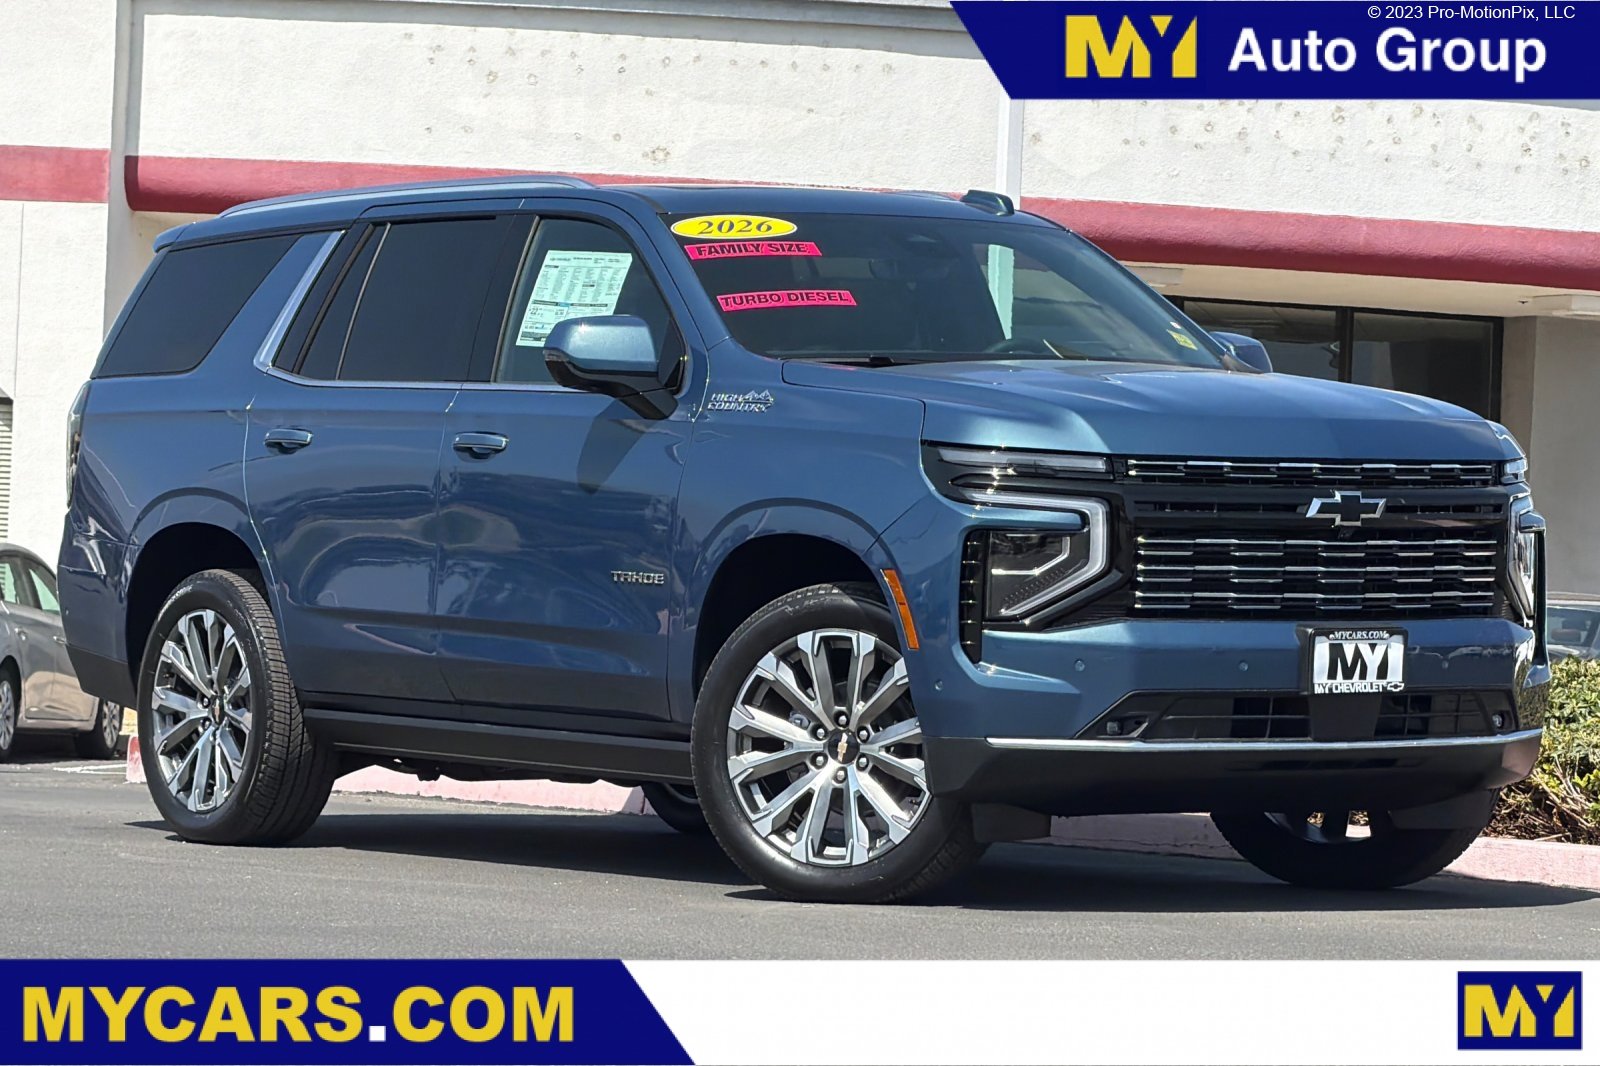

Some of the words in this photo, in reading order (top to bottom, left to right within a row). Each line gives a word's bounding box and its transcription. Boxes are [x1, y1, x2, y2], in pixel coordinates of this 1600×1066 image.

[697, 219, 773, 235] 2026
[695, 243, 762, 256] FAMILY
[767, 243, 808, 253] SIZE
[720, 292, 782, 307] TURBO
[787, 291, 849, 302] DIESEL
[710, 393, 743, 402] HIGH
[707, 402, 771, 412] COUNTRY
[611, 570, 665, 584] TAHOE
[1334, 630, 1386, 640] MYCARS.COM
[1327, 642, 1389, 681] MY
[1314, 682, 1329, 694] MY
[1332, 682, 1384, 693] CHEVROLET
